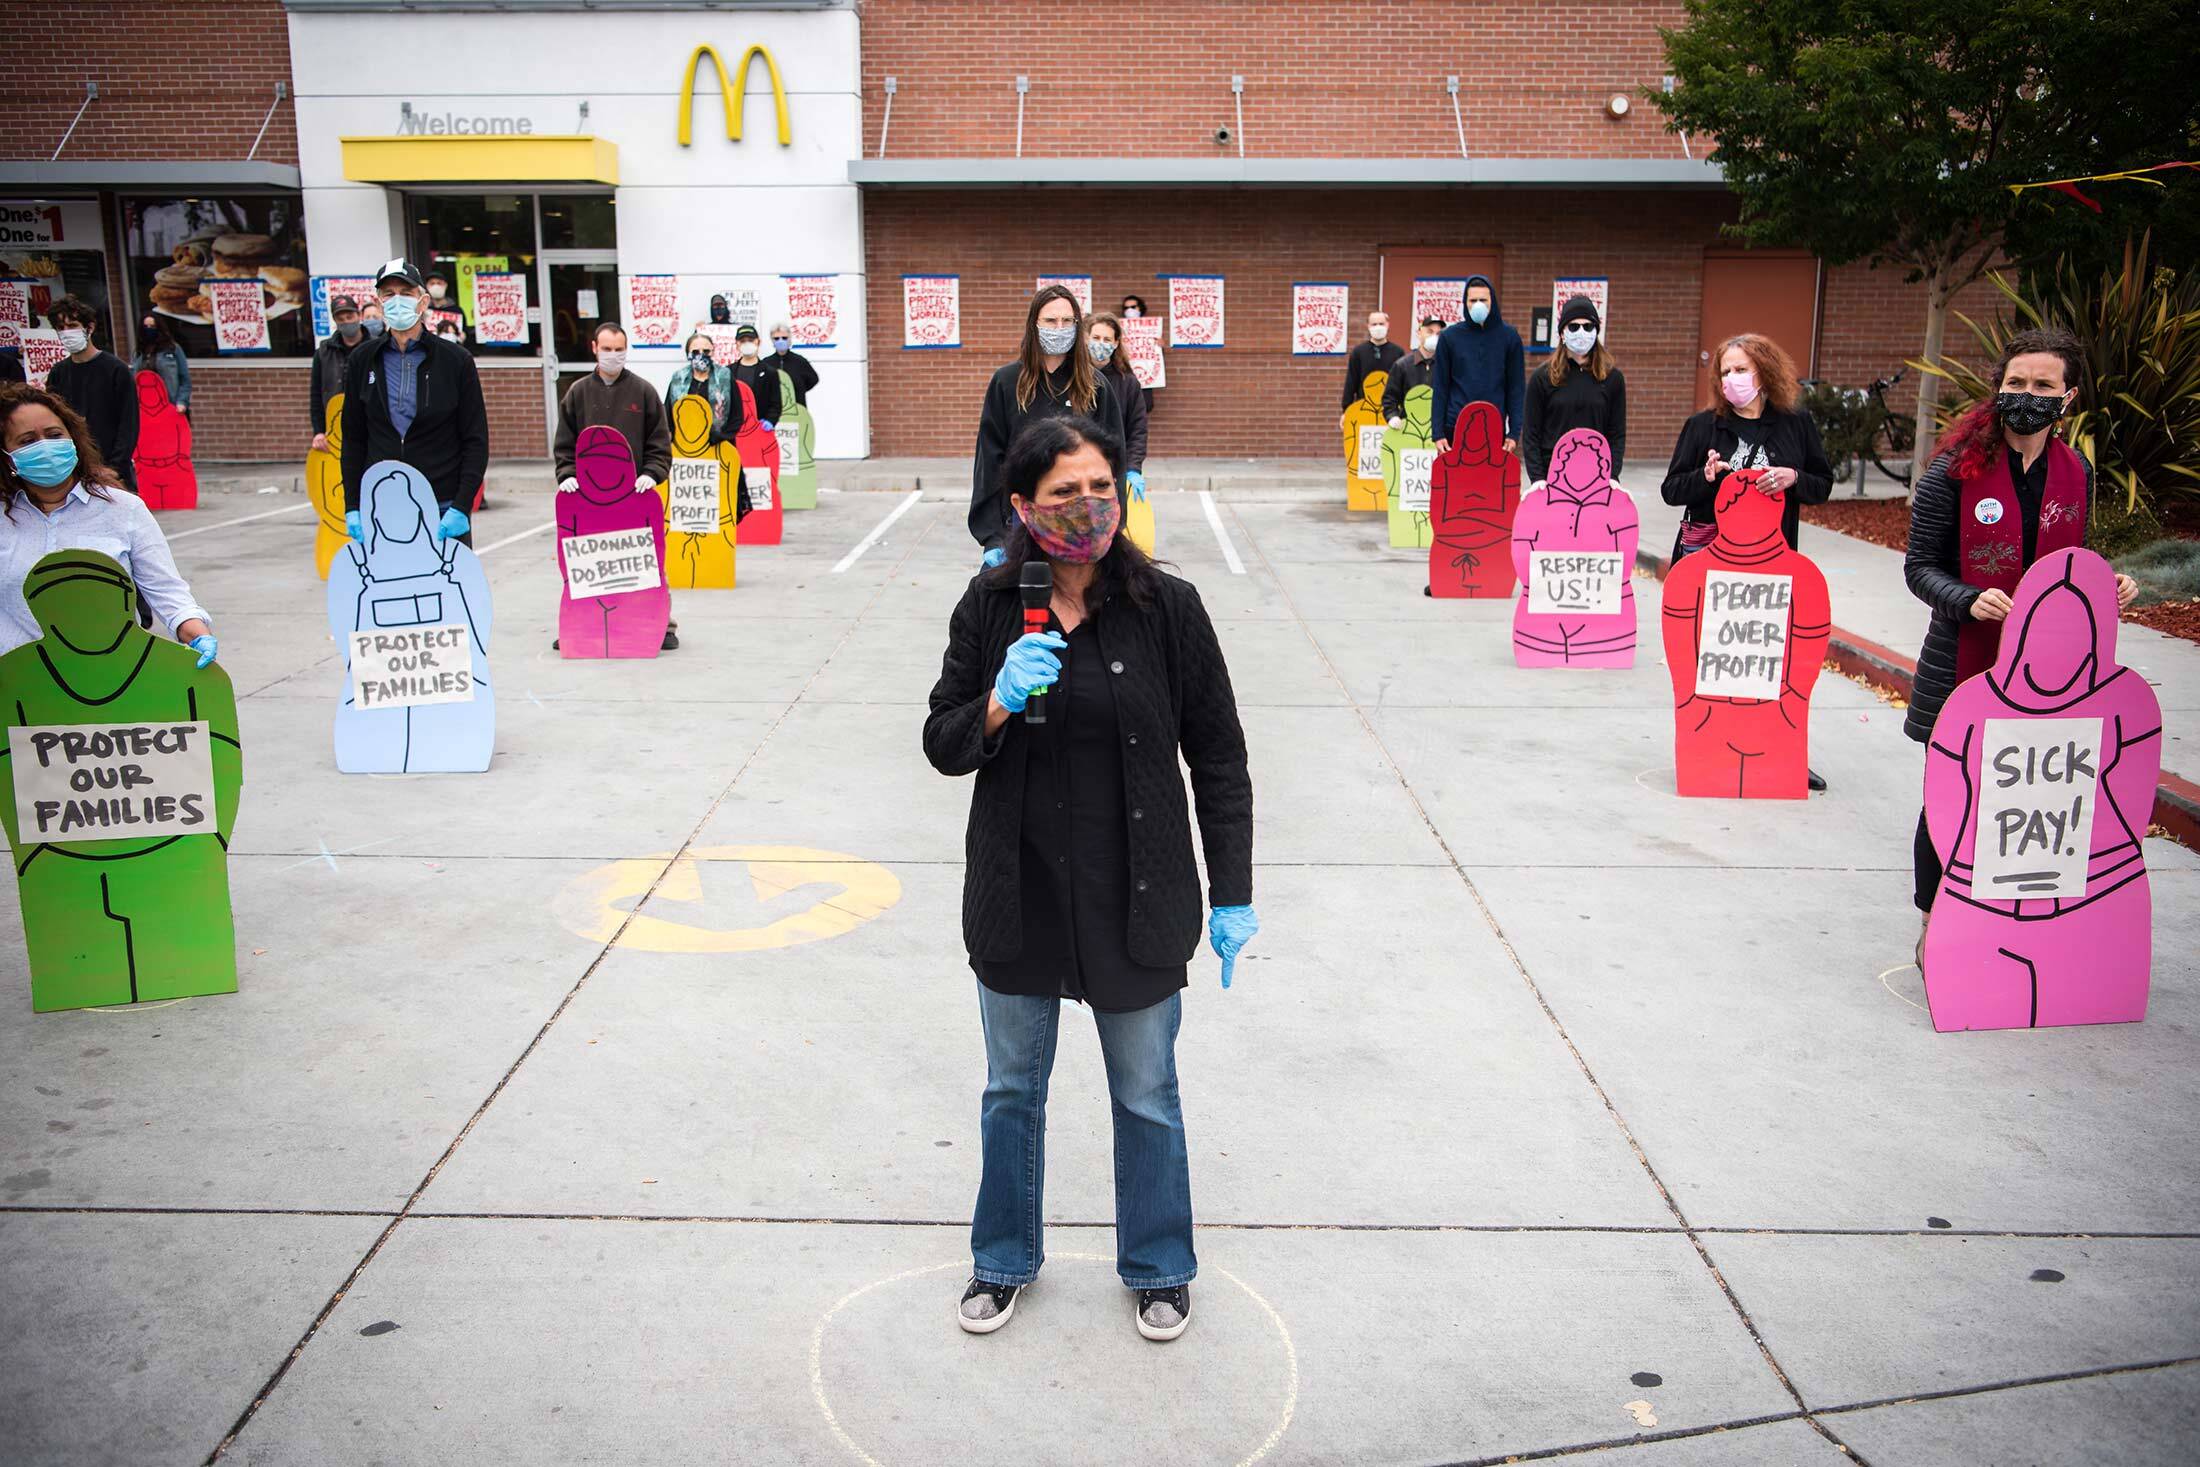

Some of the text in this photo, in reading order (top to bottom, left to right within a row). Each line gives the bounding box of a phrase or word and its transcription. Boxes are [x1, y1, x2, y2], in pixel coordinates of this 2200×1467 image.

[403, 112, 533, 136] Welcome
[37, 233, 50, 242] for
[463, 265, 502, 275] OPEN
[217, 299, 261, 310] PROTECT
[478, 292, 522, 303] PROTECT
[632, 293, 677, 306] PROTECT
[789, 293, 834, 305] PROTECT
[909, 295, 954, 307] PROTECT
[1174, 294, 1219, 306] PROTECT
[1417, 299, 1461, 310] PROTECT
[480, 307, 524, 317] WORKERS
[633, 309, 679, 320] WORKERS
[790, 309, 836, 320] WORKERS
[910, 311, 955, 321] WORKERS
[1174, 310, 1220, 320] WORKERS
[1298, 303, 1343, 315] PROTECT
[221, 314, 263, 325] WORKERS
[1298, 319, 1344, 330] WORKERS
[27, 346, 67, 359] PROTEC
[1362, 431, 1383, 449] PP
[1361, 456, 1381, 472] NO
[1404, 455, 1434, 471] SIC
[672, 463, 717, 484] PEOPLE
[675, 485, 716, 500] OVER
[671, 505, 719, 521] PROFIT
[571, 554, 658, 584] DO BETTER
[1540, 557, 1621, 578] RESPECT
[1548, 577, 1601, 604] US!!
[1709, 581, 1790, 612] PEOPLE
[1718, 620, 1784, 647] OVER
[356, 628, 465, 658] PROTECT
[388, 651, 440, 672] OUR
[1700, 652, 1783, 682] PROFIT
[361, 670, 470, 706] FAMILIES
[30, 726, 197, 768] PROTECT
[1993, 741, 2095, 788] SICK
[70, 764, 153, 792] OUR
[34, 793, 205, 833] FAMILIES
[1994, 795, 2082, 857] PAY!
